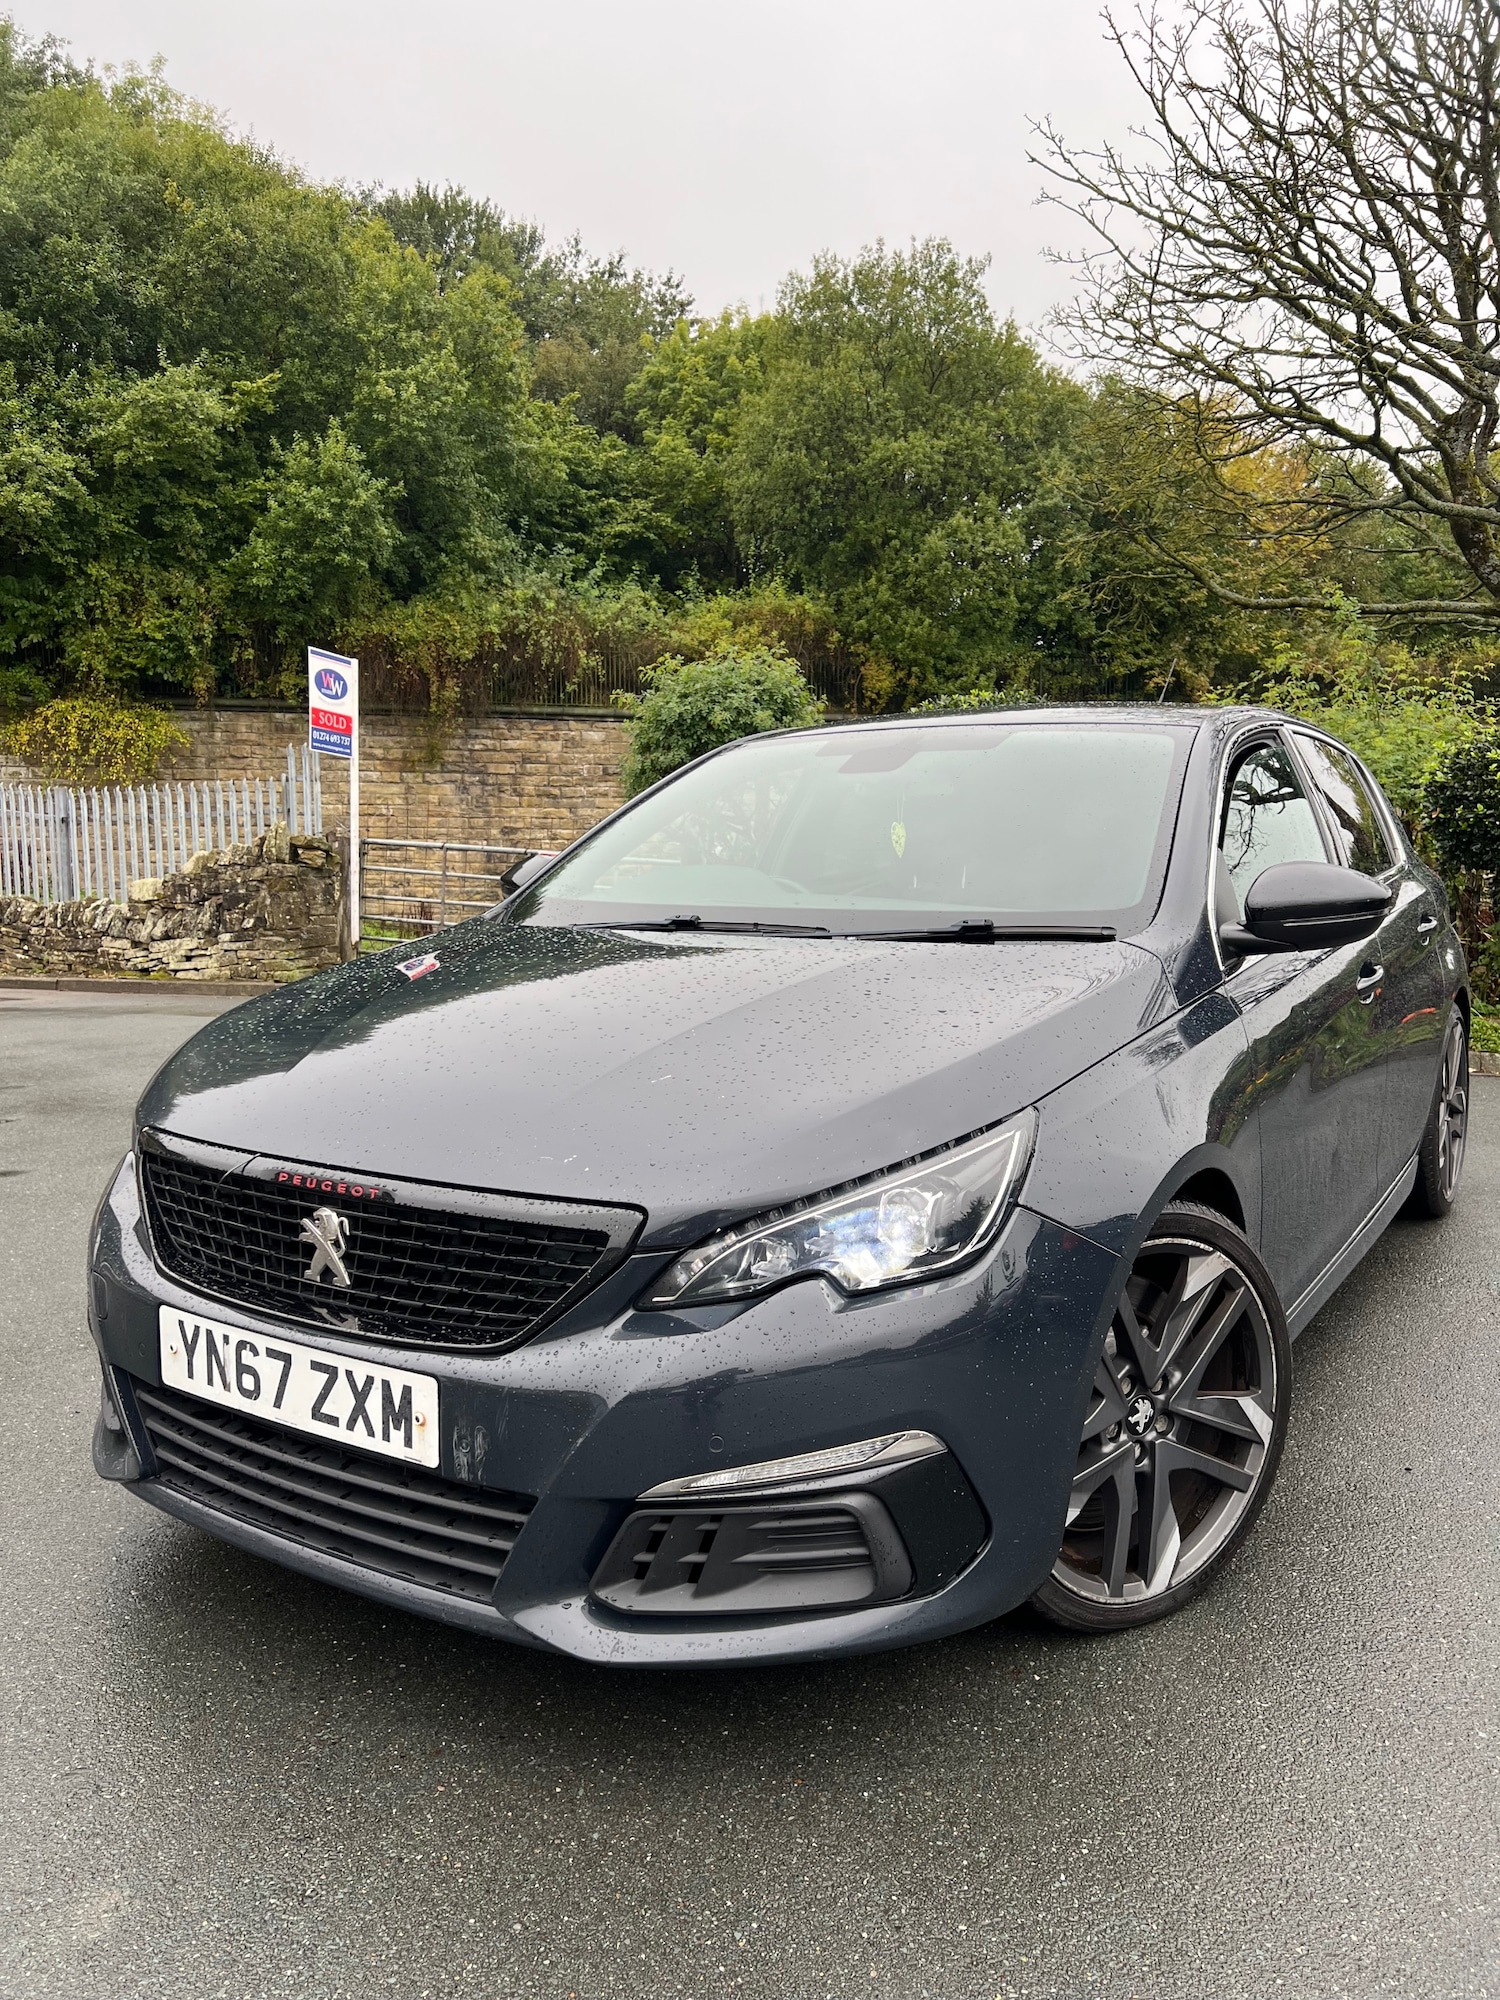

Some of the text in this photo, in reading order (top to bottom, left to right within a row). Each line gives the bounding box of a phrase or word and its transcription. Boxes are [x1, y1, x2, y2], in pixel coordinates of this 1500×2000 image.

[319, 711, 347, 729] SOLD
[312, 730, 350, 746] 01274 693 737
[278, 1172, 379, 1199] PEUGEOT
[178, 1320, 413, 1449] YN67 ZXM
